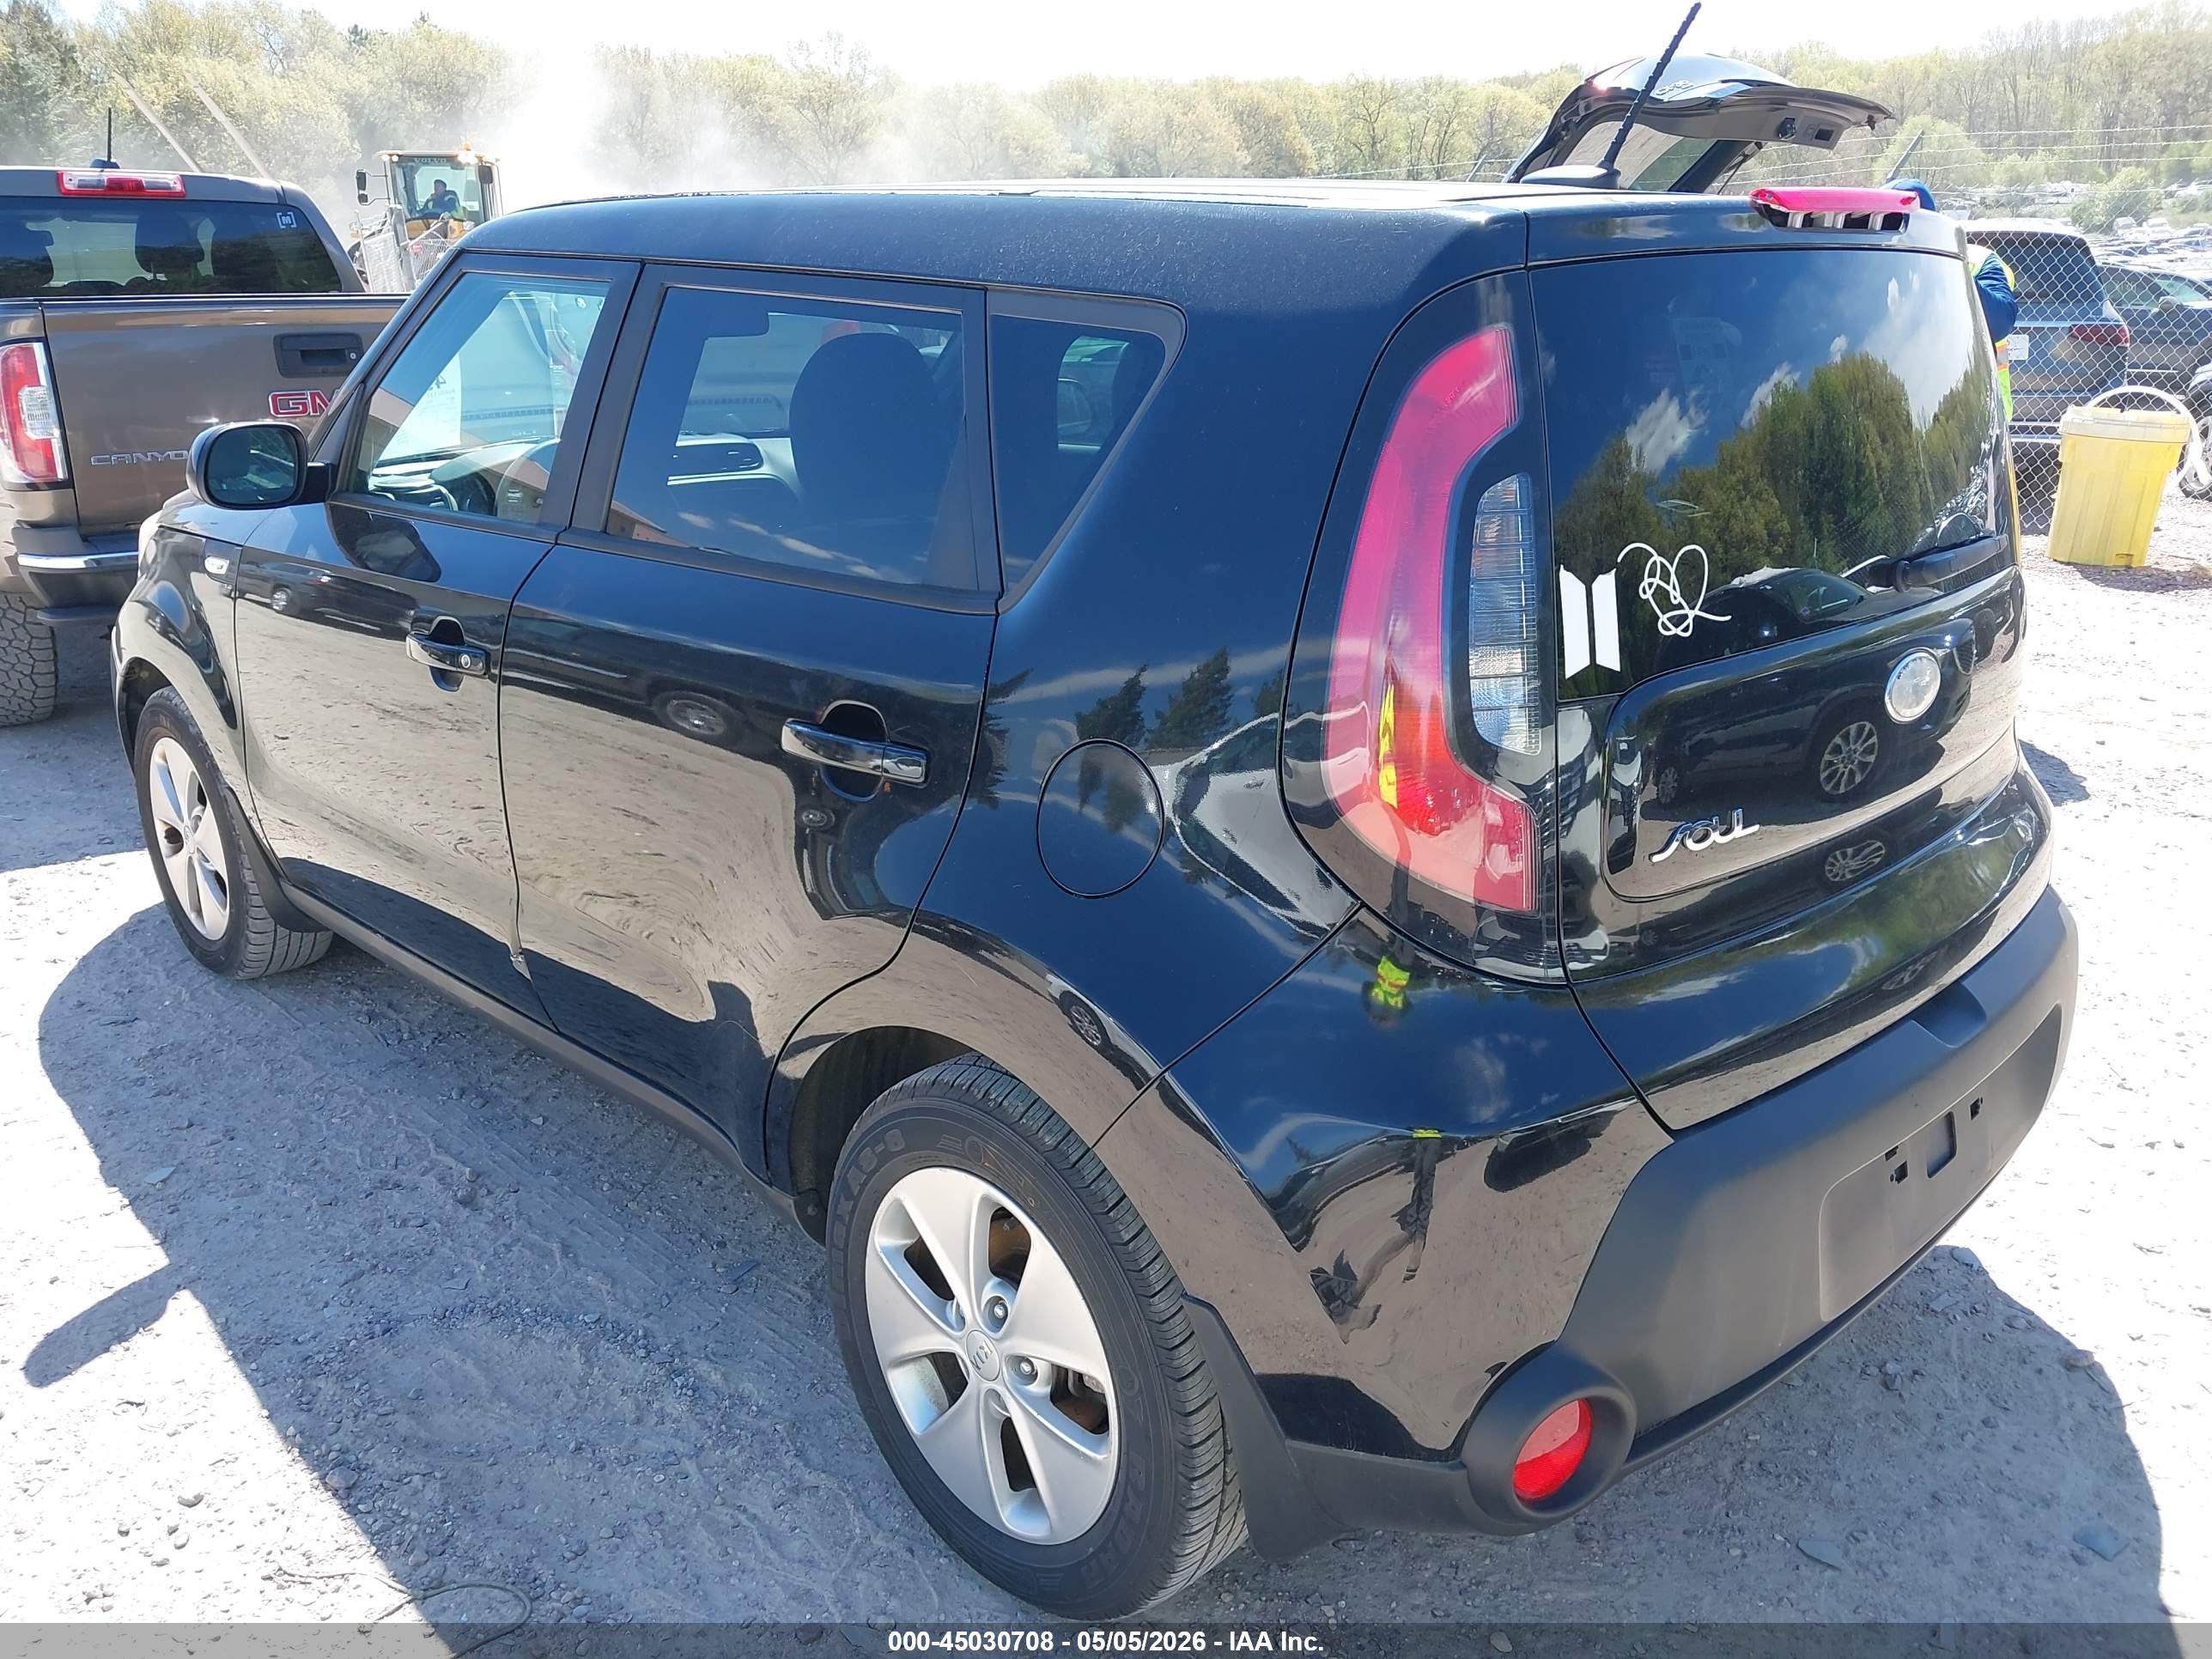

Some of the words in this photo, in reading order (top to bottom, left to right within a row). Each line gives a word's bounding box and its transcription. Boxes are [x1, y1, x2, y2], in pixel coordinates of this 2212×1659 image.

[268, 390, 331, 417] GM
[90, 450, 189, 465] CANYO
[1649, 808, 1760, 863] SOUL
[969, 1339, 994, 1371] KIA
